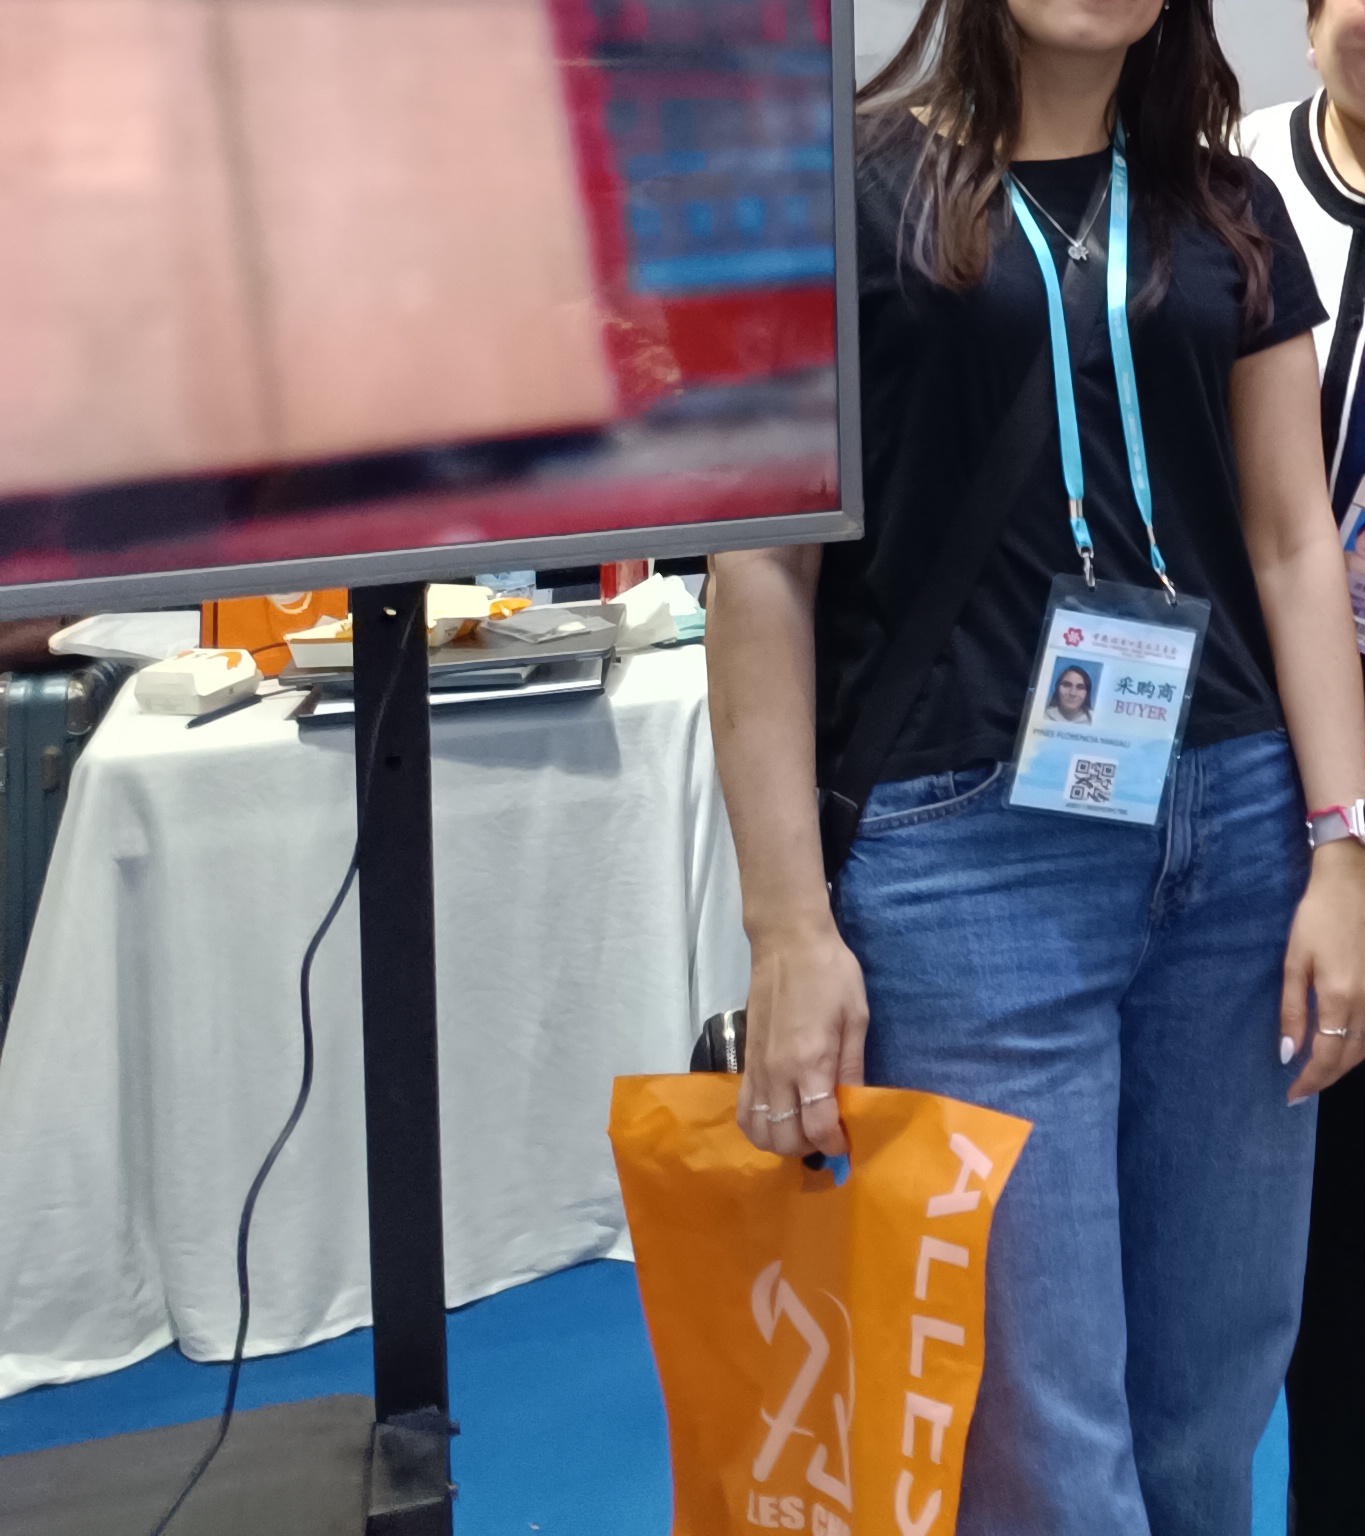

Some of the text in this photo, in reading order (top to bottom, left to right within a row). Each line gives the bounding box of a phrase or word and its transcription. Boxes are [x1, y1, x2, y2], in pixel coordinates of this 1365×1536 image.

[1114, 675, 1178, 704] 采购商
[1113, 698, 1168, 722] BUYER
[893, 1132, 994, 1536] ALLES
